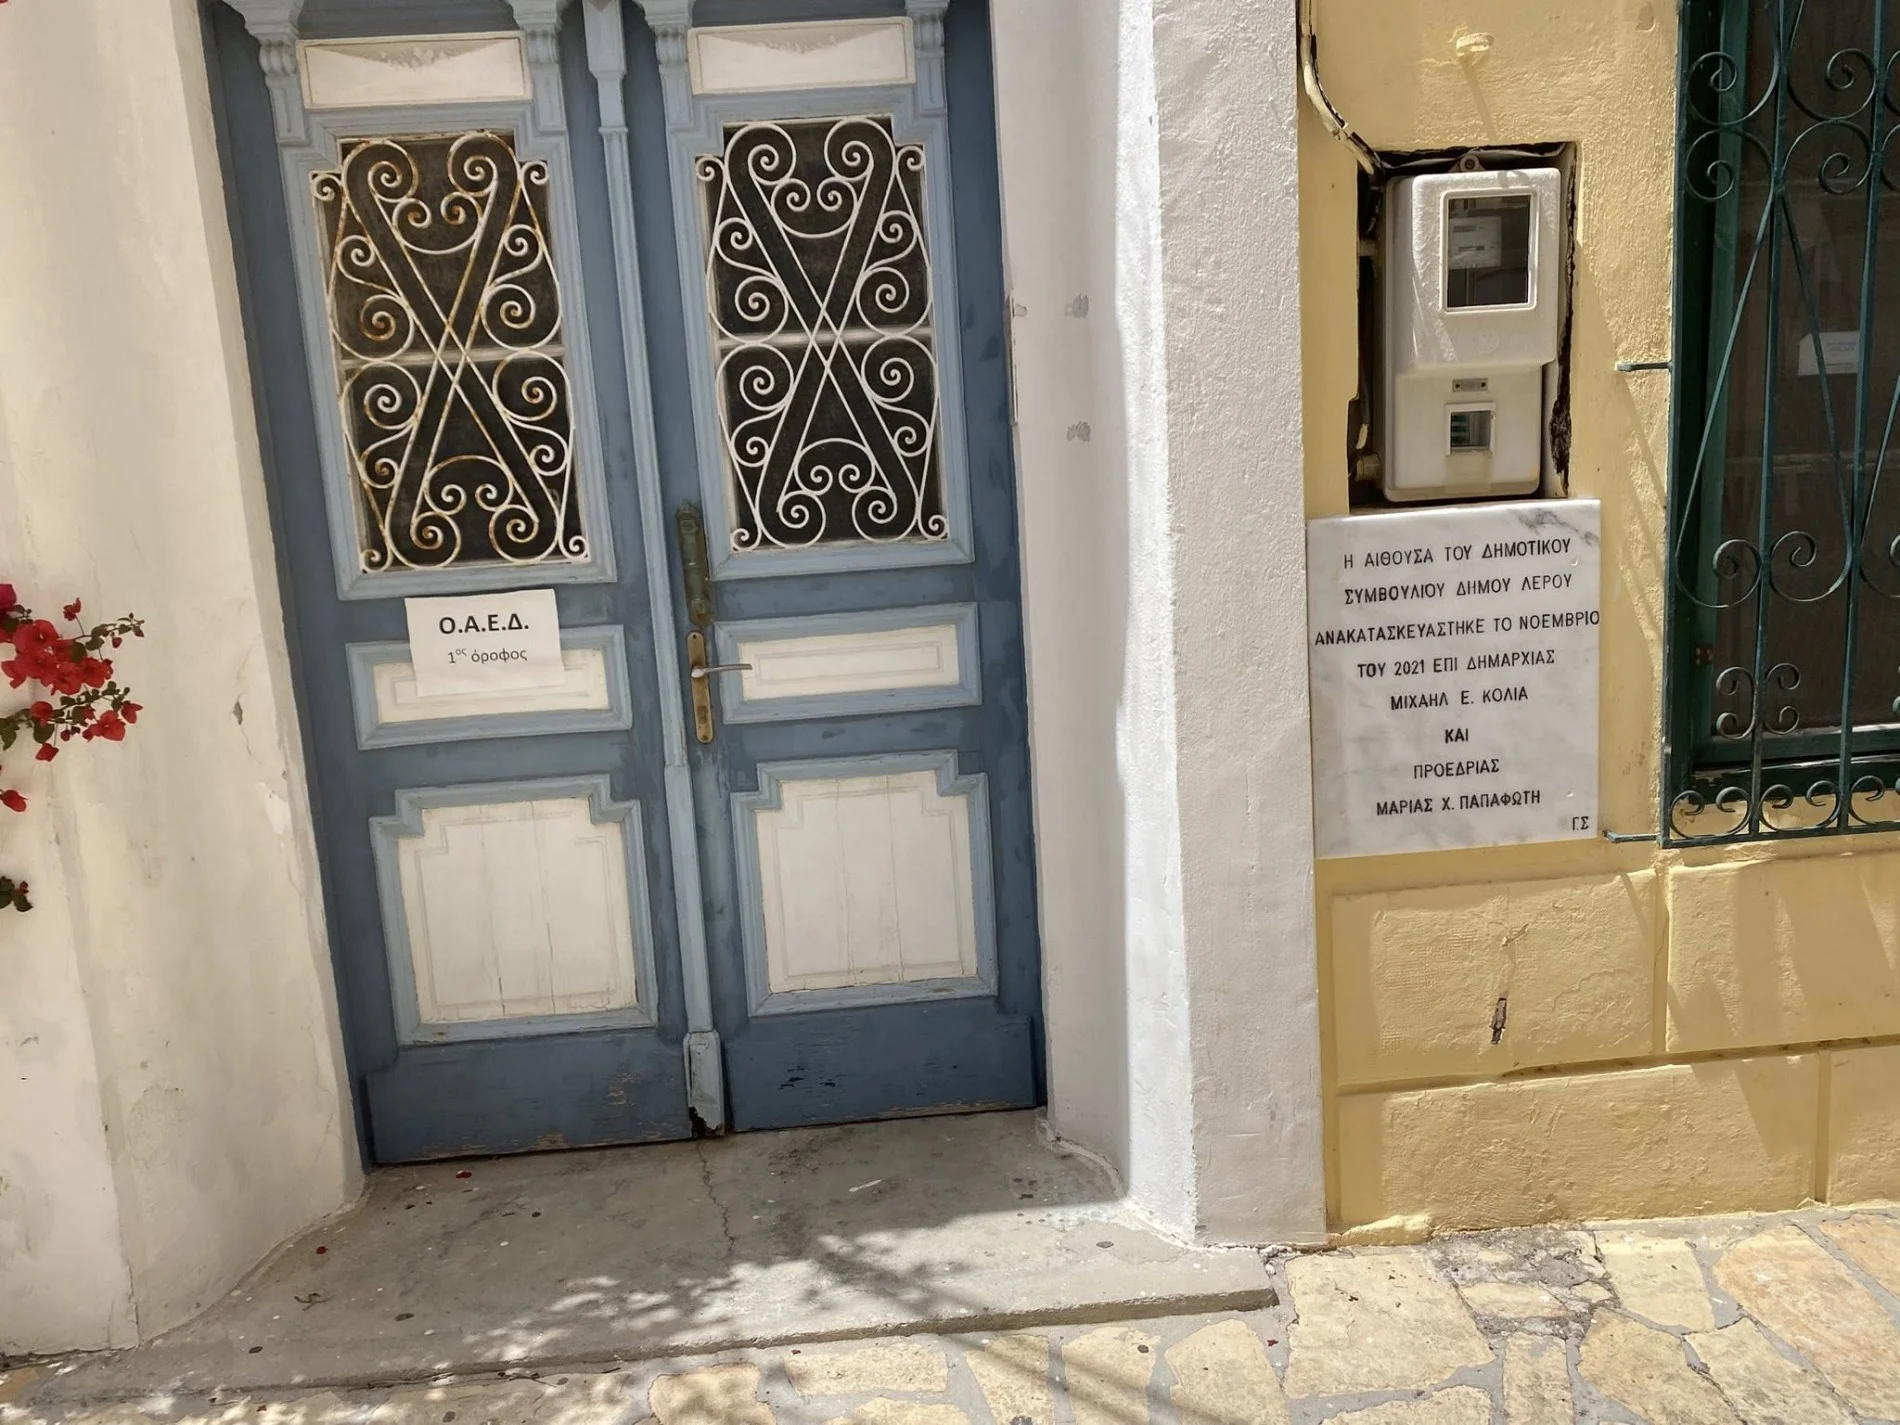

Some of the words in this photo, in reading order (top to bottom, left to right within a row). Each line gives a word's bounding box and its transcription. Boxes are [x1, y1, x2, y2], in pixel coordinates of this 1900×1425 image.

[1344, 554, 1353, 568] Η
[1364, 548, 1434, 567] ΑΙΘΟΥΣΑ
[1444, 545, 1472, 562] ΤΟΥ
[1482, 538, 1571, 559] ΔΗΜΟΤΙΚΟΥ
[1345, 583, 1445, 605] ΣΥΜΒΟΥΛΙΟΥ
[1456, 578, 1511, 596] ΔΗΜΟΥ
[1521, 574, 1573, 591] ΛΕΡΟΥ
[439, 613, 529, 634] Ο.Α.Ε.Δ.
[1315, 619, 1485, 646] ΑΝΑΚΑΤΑΣΚΕΥΑΣΤΗΚΕ
[1493, 616, 1512, 631] ΤΟ
[1519, 611, 1600, 629] ΝΟΕΜΒΡΙΟ
[471, 649, 528, 664] όροφος
[1357, 663, 1386, 678] ΤΟΥ
[1394, 659, 1425, 676] 2021
[1433, 657, 1458, 672] ΕΠΙ
[1467, 650, 1555, 670] ΔΗΜΑΡΧΙΑΣ
[1391, 692, 1448, 710] ΜΙΧΑΗΛ
[1461, 690, 1474, 705] Ε.
[1482, 686, 1528, 703] ΚΟΛΙΑ
[1445, 728, 1469, 744] ΚΑΙ
[1414, 759, 1500, 778] ΠΡΟΕΔΡΙΑΣ
[1376, 799, 1433, 816] ΜΑΡΙΑΣ
[1442, 796, 1454, 810] Χ.
[1460, 790, 1540, 810] ΠΑΠΑΦΩΤΗ
